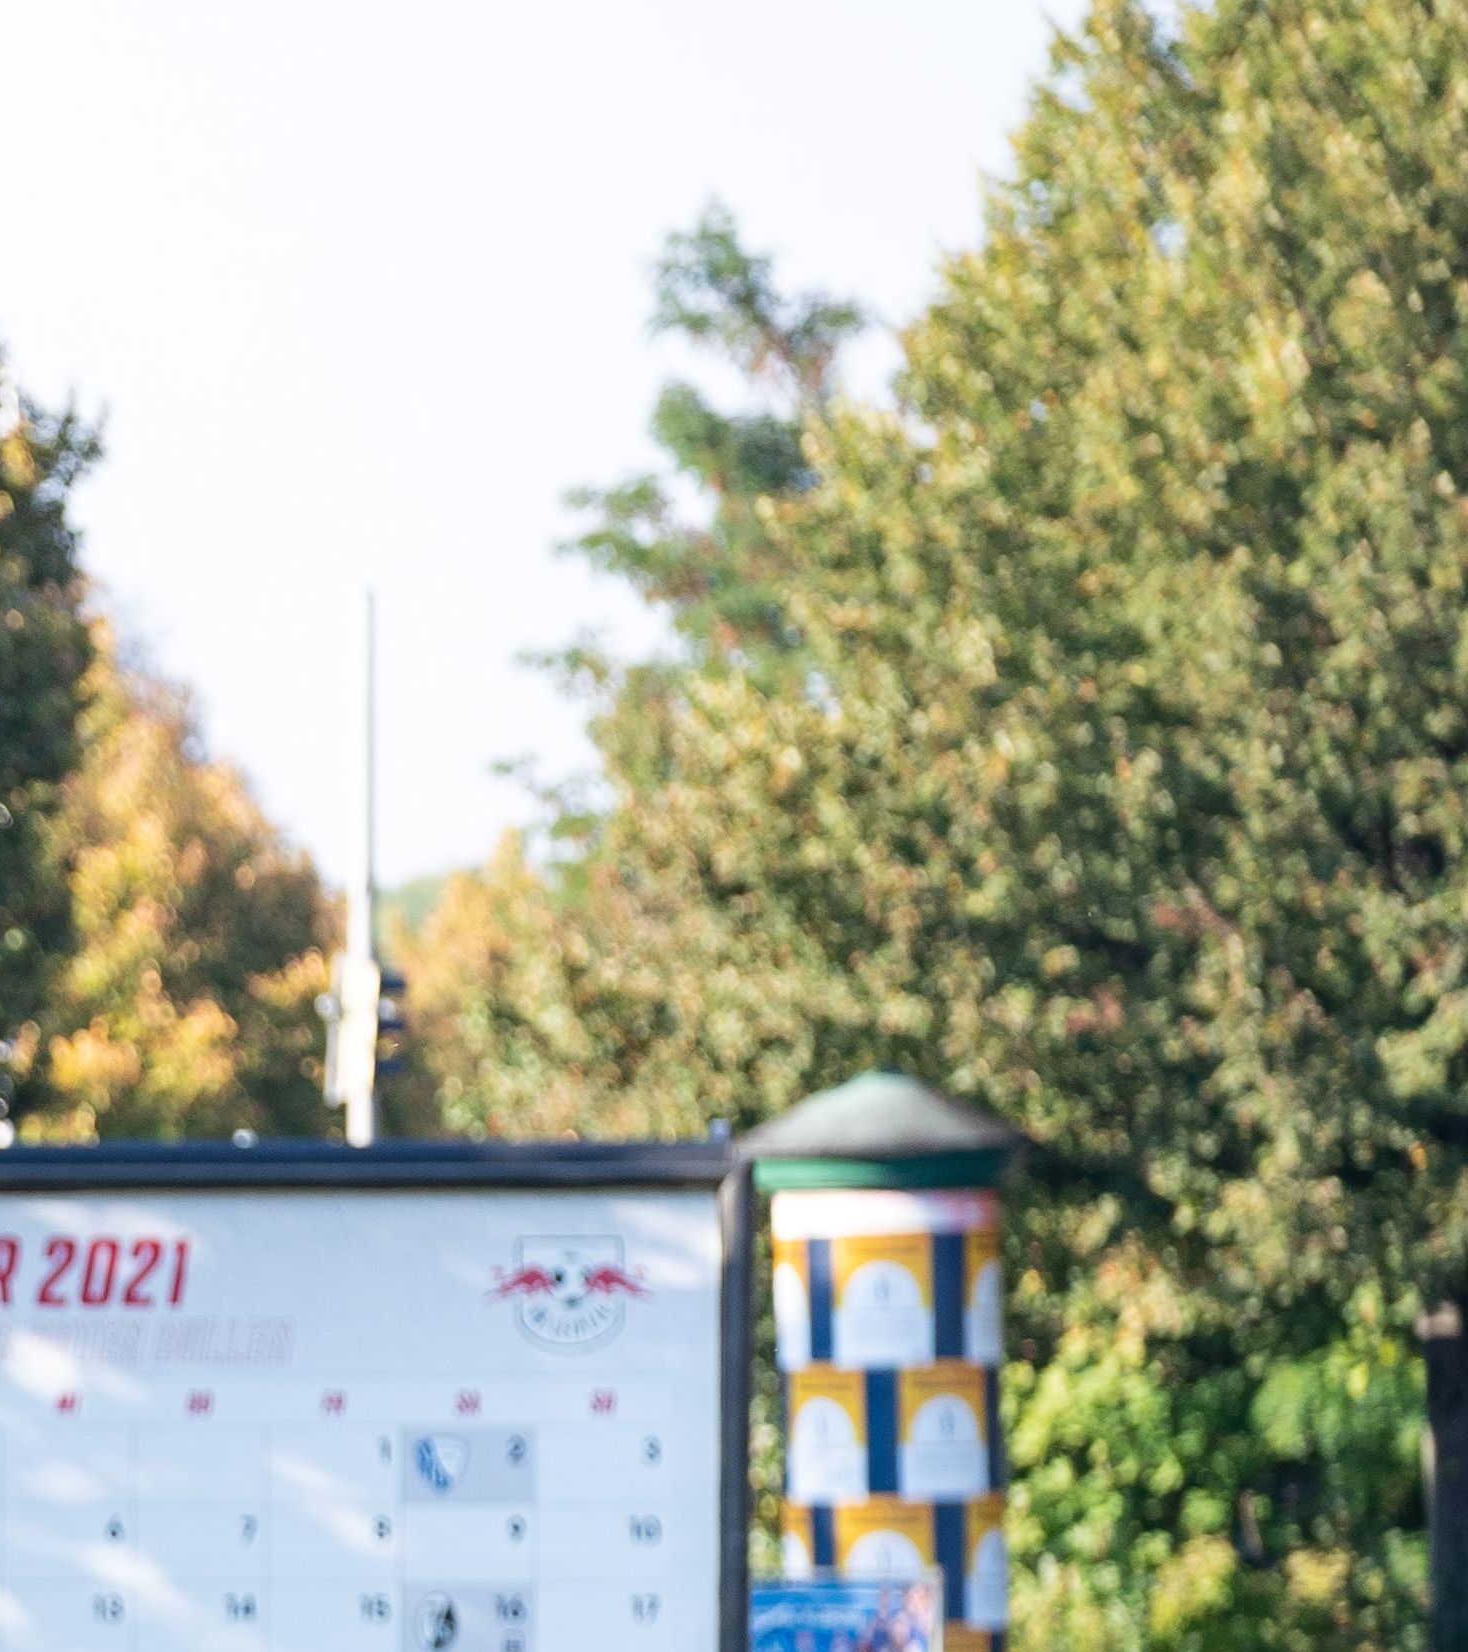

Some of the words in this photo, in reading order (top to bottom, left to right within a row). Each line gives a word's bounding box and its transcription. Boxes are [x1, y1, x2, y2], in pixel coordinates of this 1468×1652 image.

[36, 1236, 188, 1307] 2021
[628, 1513, 662, 1545] 10
[631, 1593, 659, 1625] 17
